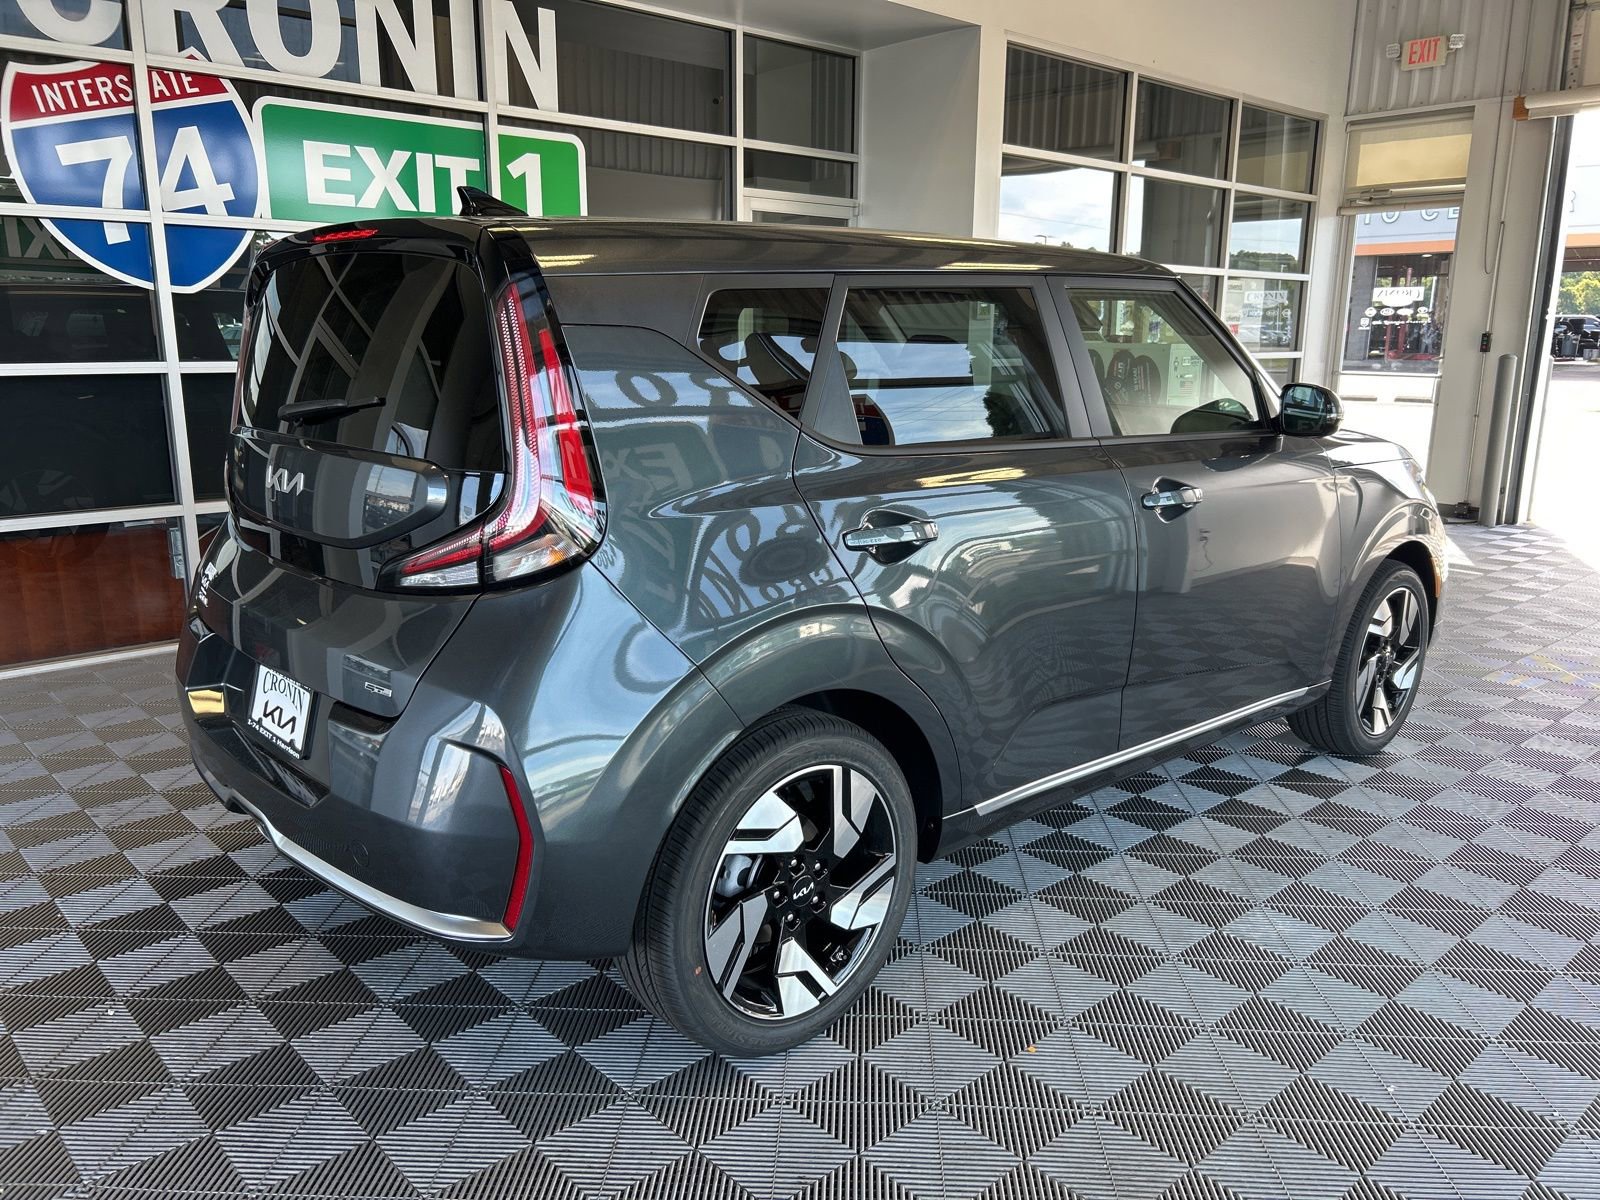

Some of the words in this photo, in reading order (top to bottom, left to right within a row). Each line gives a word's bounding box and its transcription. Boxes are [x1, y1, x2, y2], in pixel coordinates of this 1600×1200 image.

[1408, 37, 1440, 65] EXIT
[31, 71, 201, 114] INTERSATE
[54, 126, 235, 245] 74
[303, 140, 480, 215] EXIT
[506, 152, 544, 217] 1
[265, 464, 304, 497] KIA
[263, 671, 306, 716] CRONIN
[262, 699, 297, 734] KIA
[793, 882, 814, 900] KIA
